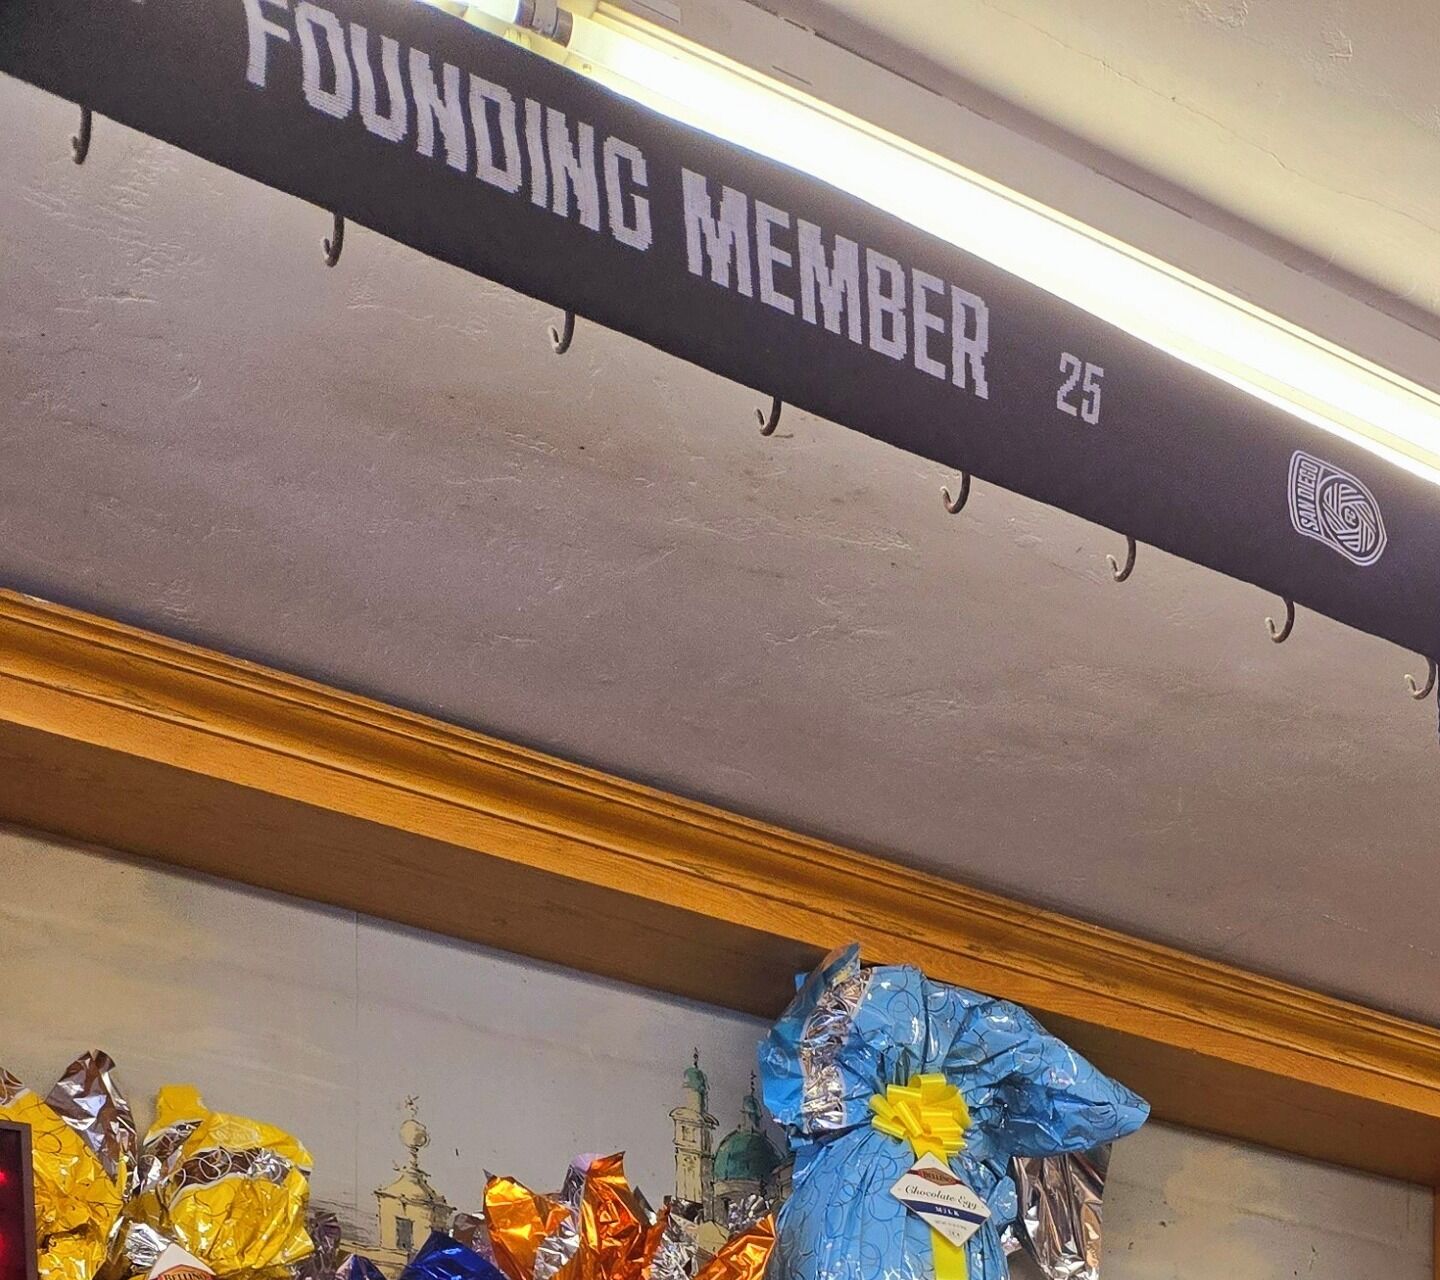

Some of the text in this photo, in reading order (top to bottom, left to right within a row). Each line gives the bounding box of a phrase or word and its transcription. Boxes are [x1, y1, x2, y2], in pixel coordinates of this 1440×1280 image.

[245, 0, 988, 399] FOUNDING MEMBER
[1056, 352, 1104, 424] 25
[1298, 462, 1319, 531] SAN DIEGO
